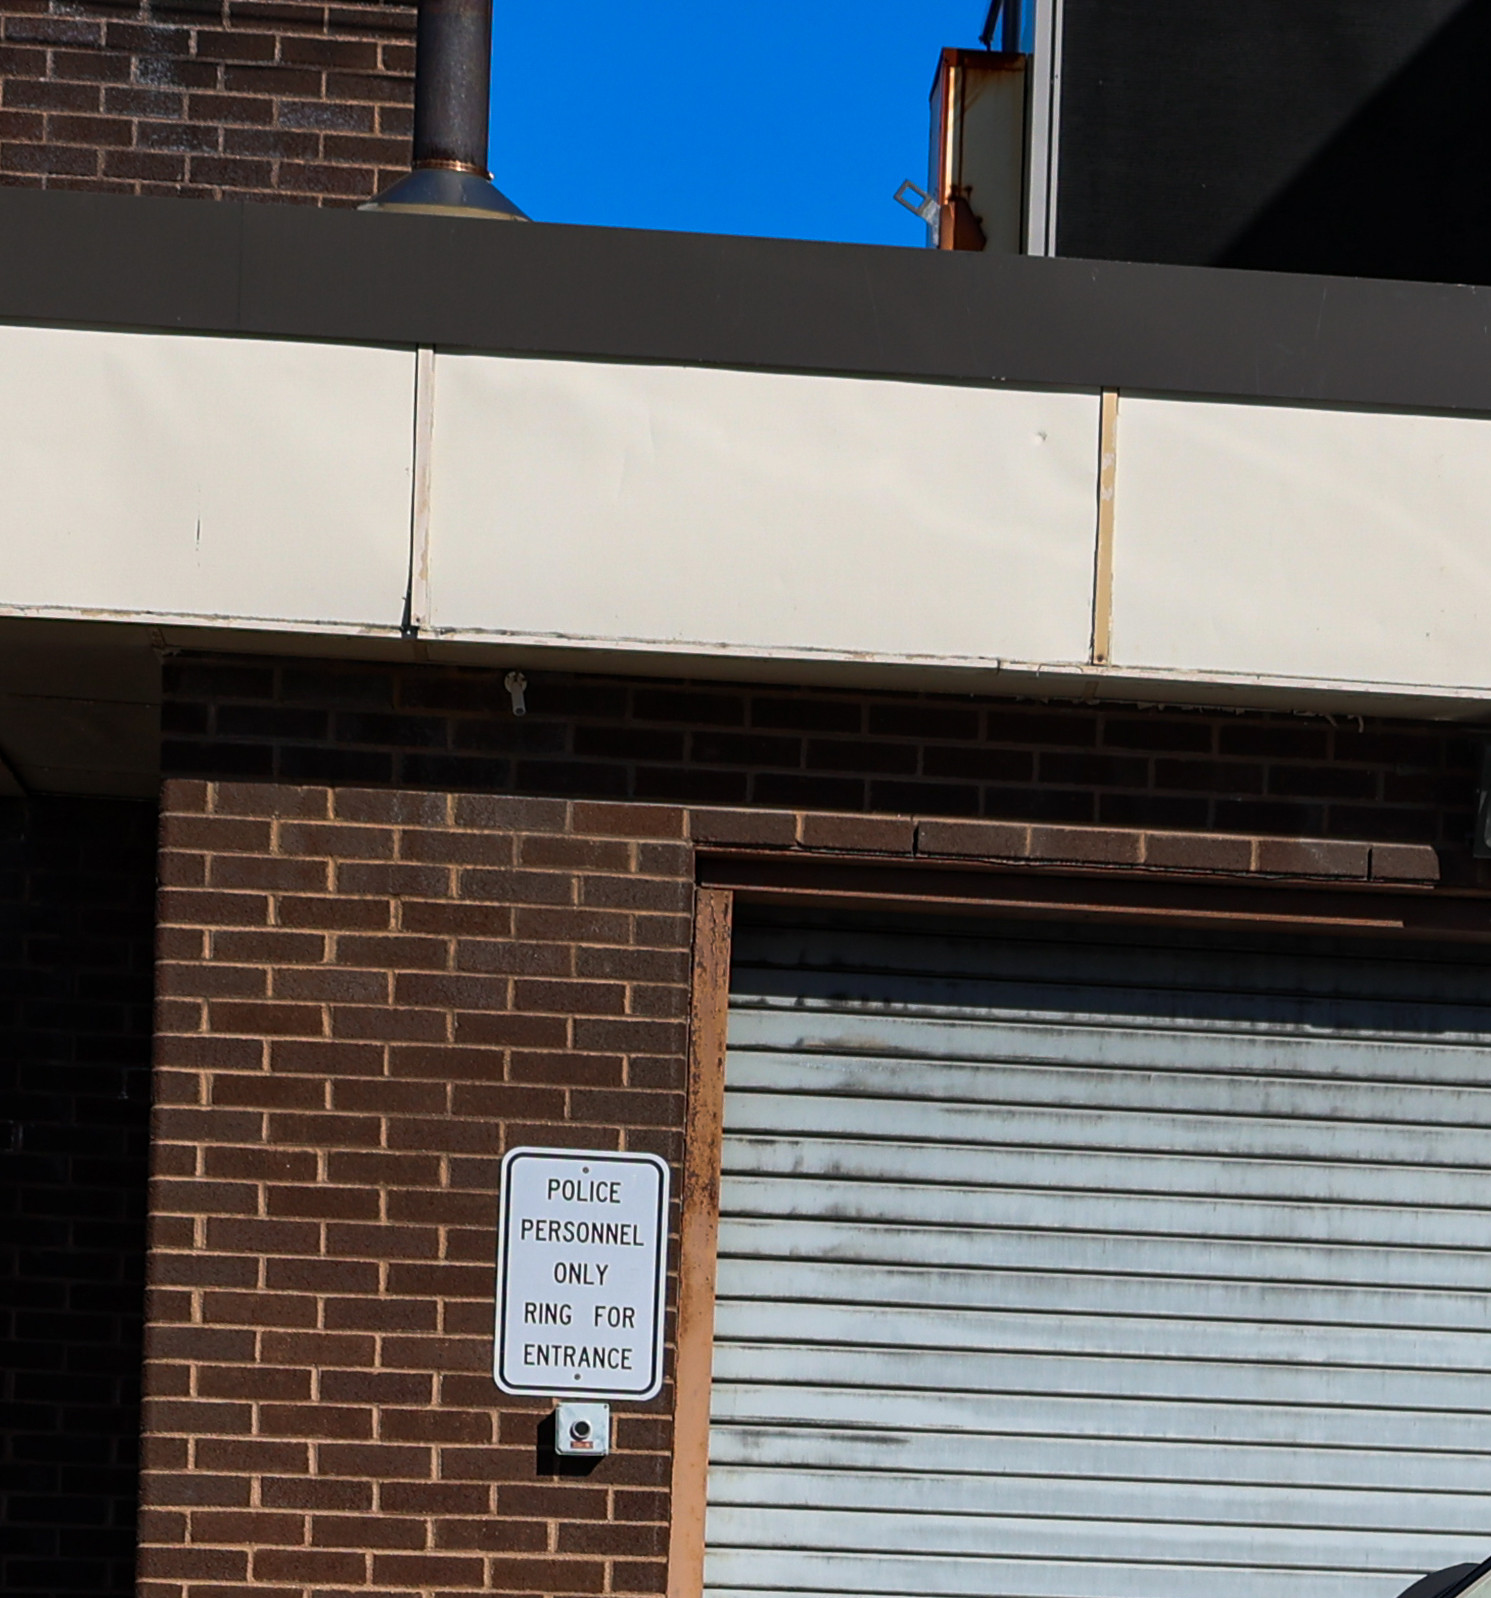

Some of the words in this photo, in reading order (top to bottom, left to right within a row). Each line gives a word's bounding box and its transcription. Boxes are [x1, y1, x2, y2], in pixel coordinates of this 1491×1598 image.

[547, 1178, 622, 1204] POLICE
[520, 1219, 645, 1247] PERSONNEL
[553, 1261, 609, 1286] ONLY
[523, 1302, 572, 1326] RING
[593, 1305, 636, 1329] FOR
[523, 1344, 633, 1370] ENTRANCE
